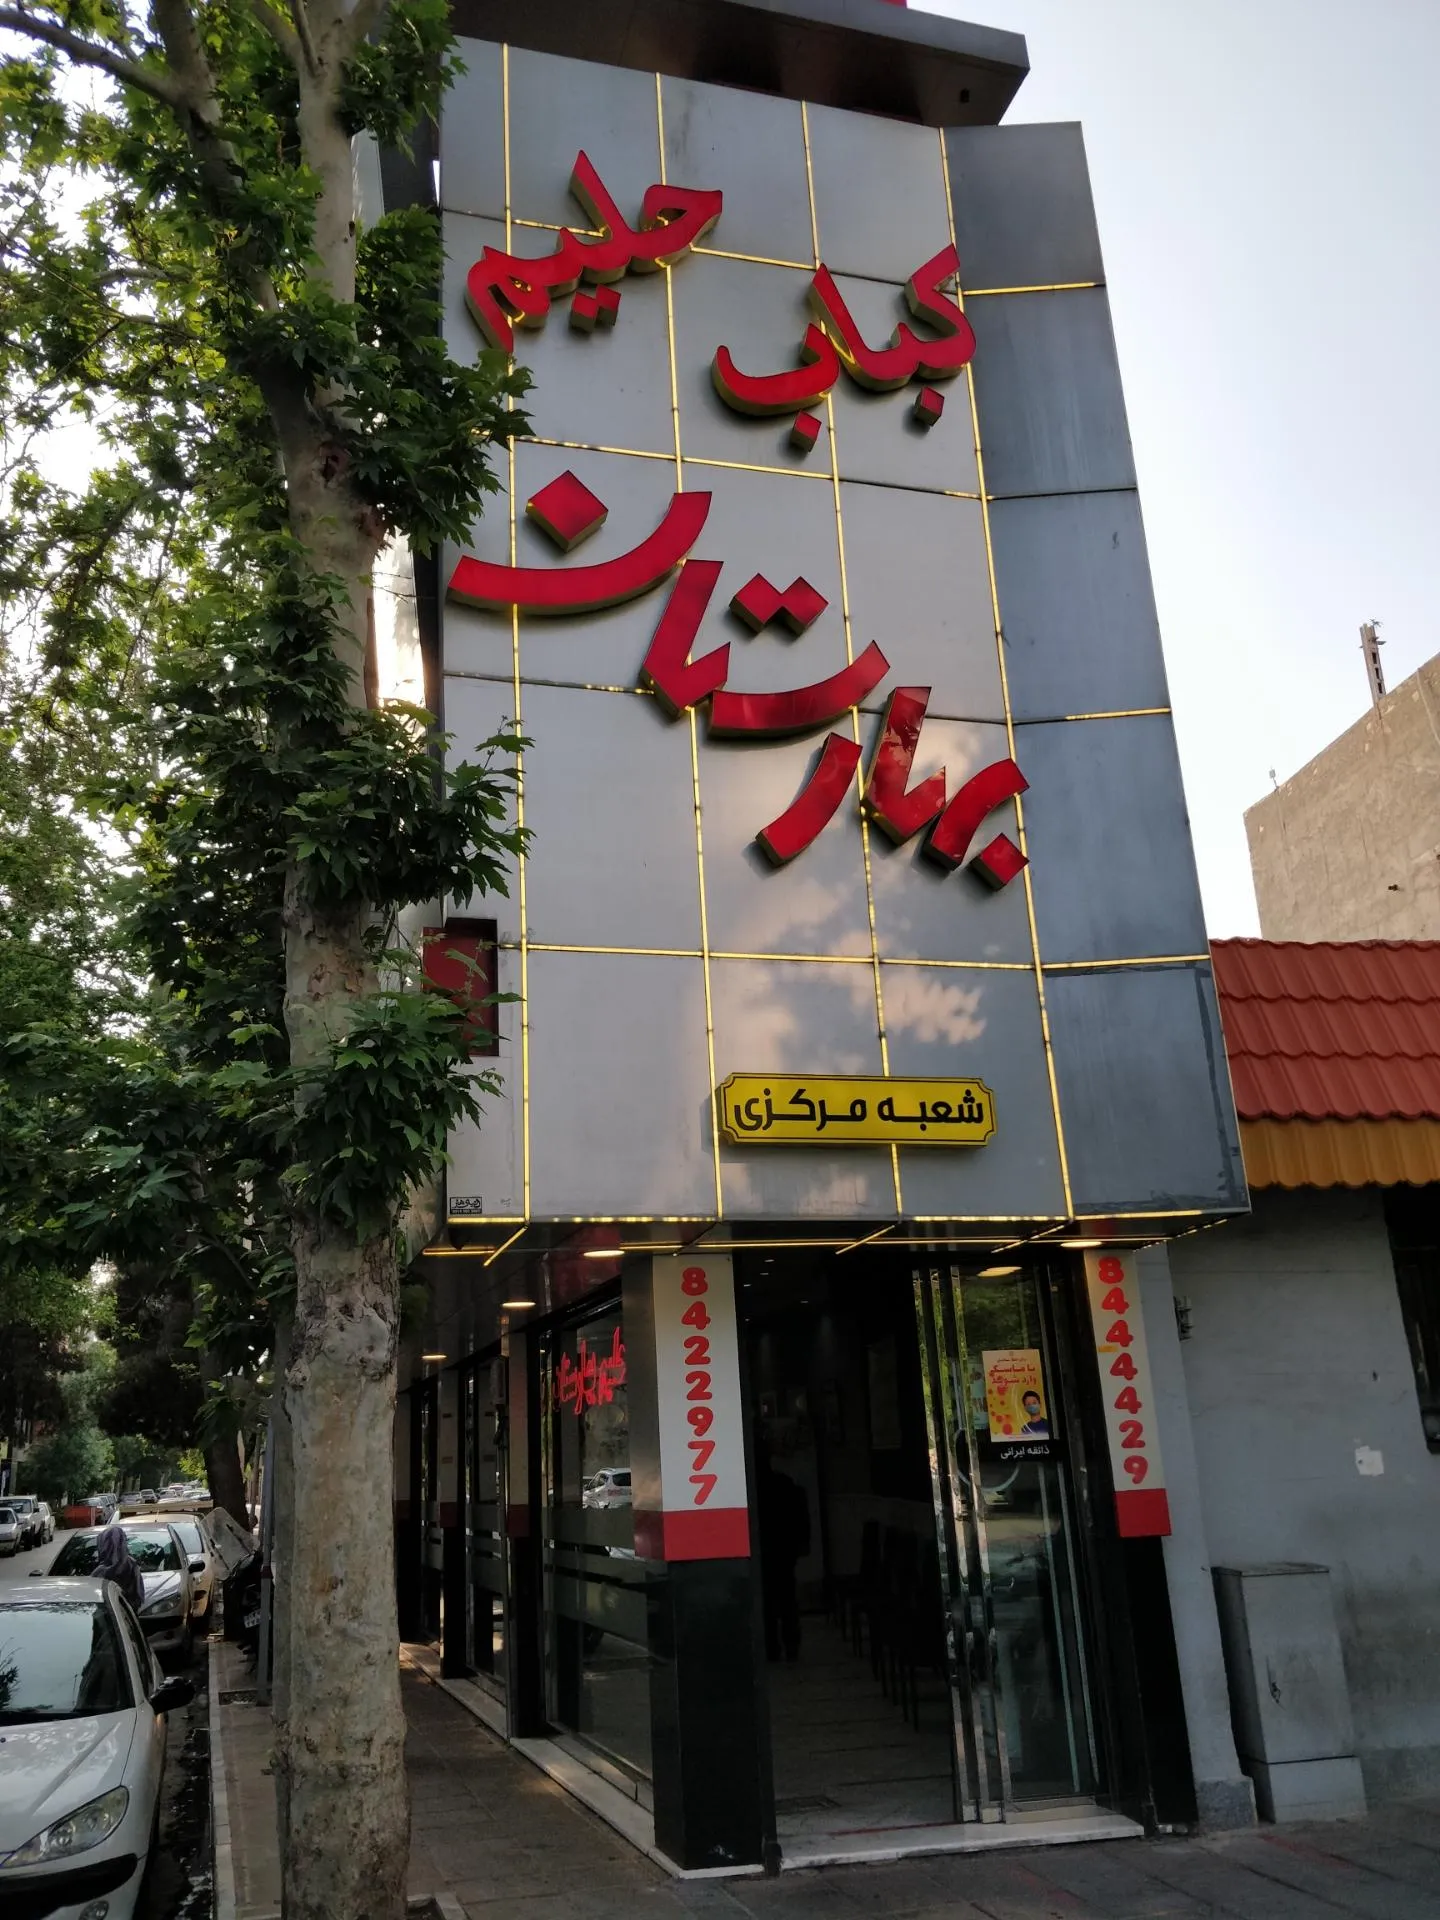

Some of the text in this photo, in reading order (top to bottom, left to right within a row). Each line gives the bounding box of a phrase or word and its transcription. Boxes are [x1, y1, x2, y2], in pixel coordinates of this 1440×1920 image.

[465, 150, 723, 353] حلیم
[712, 243, 977, 452] کباب
[734, 1088, 984, 1131] شعبه مرکزی
[681, 1266, 718, 1506] 8422977
[1000, 1446, 1025, 1460] ایرانی
[1098, 1256, 1149, 1485] 8444429
